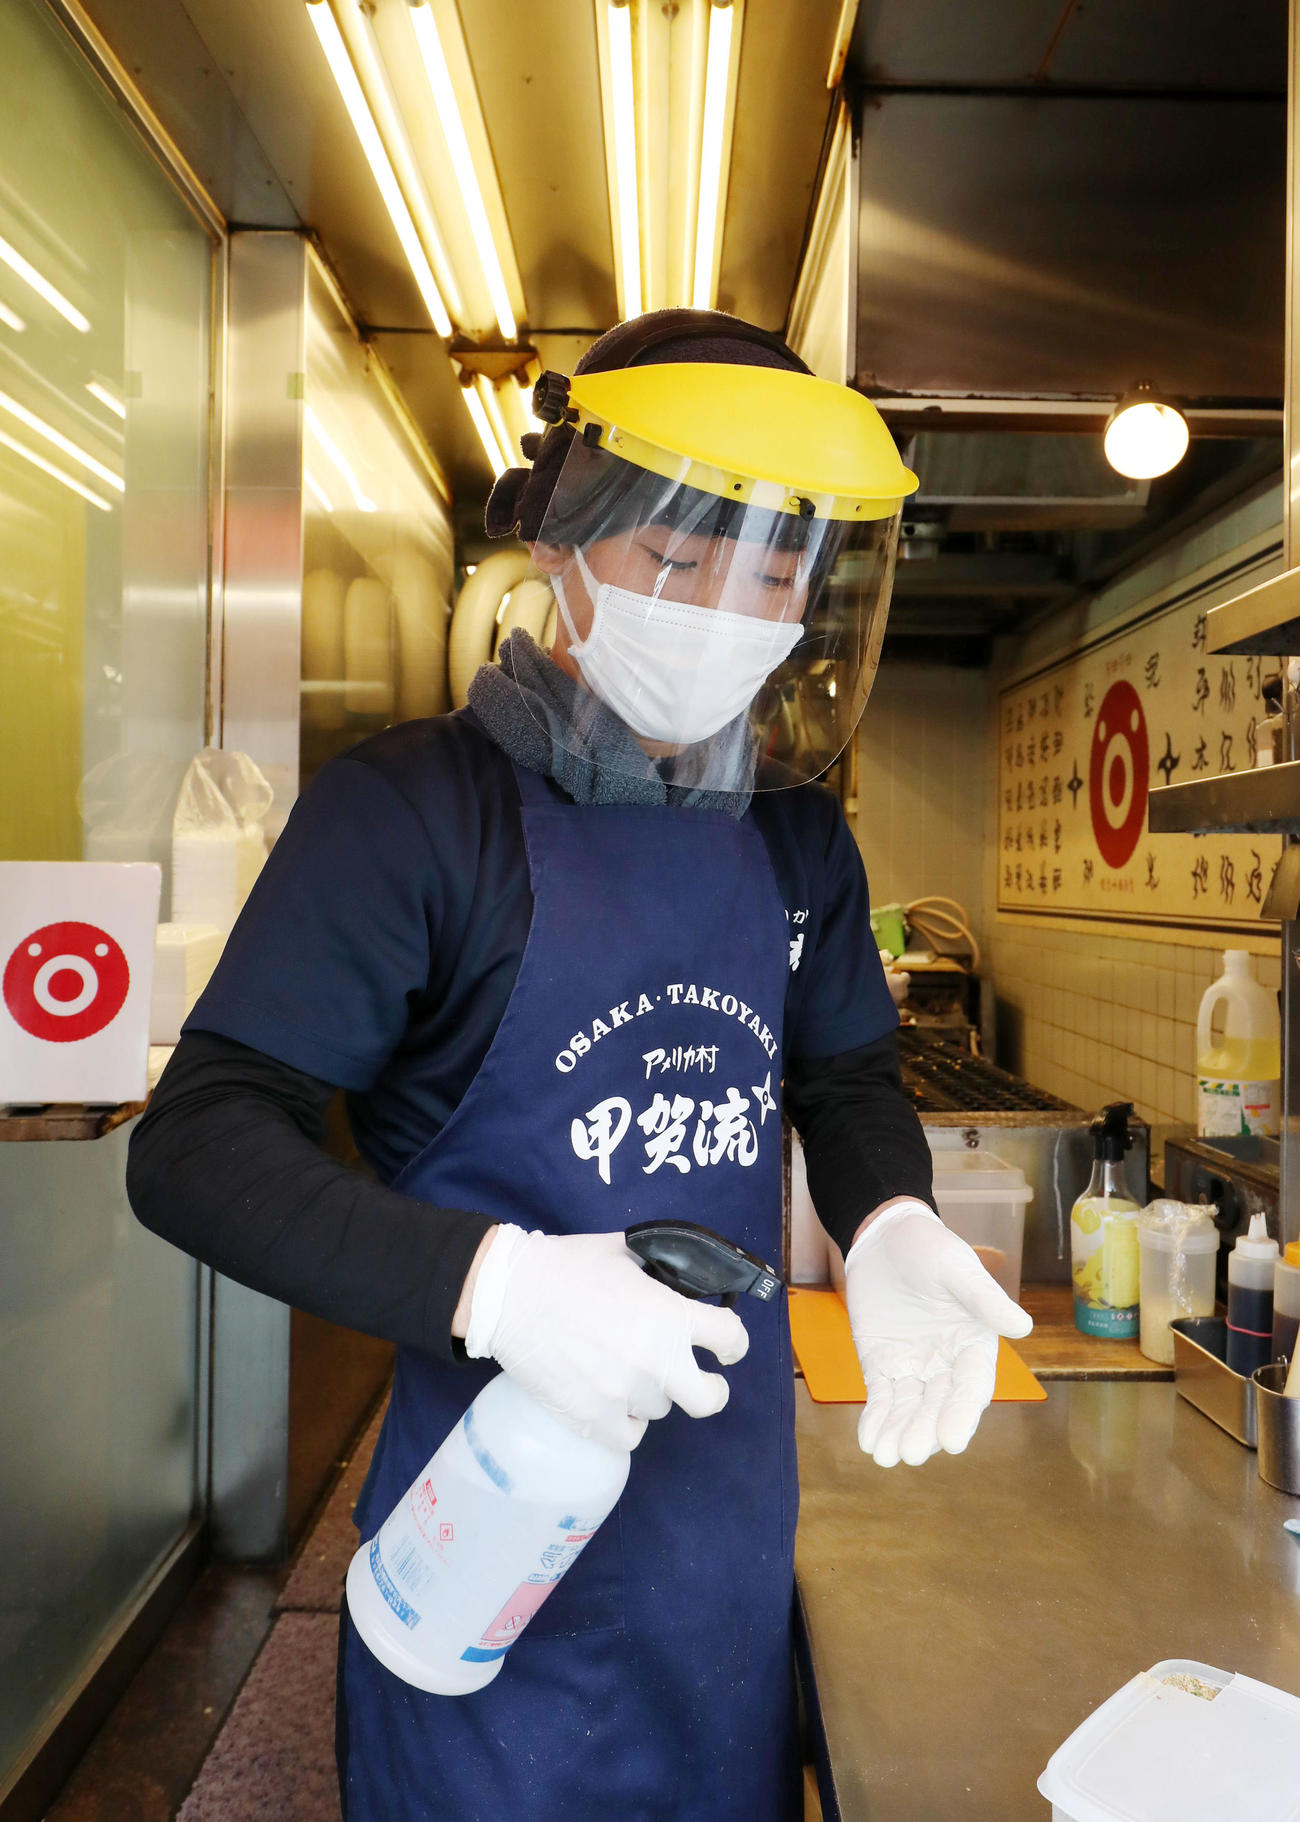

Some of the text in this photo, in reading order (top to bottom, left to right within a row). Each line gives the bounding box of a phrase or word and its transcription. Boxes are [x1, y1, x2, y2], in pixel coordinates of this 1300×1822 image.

[642, 1045, 719, 1079] アメリカ村
[570, 1087, 759, 1185] 甲賀流
[757, 1278, 775, 1299] OFF
